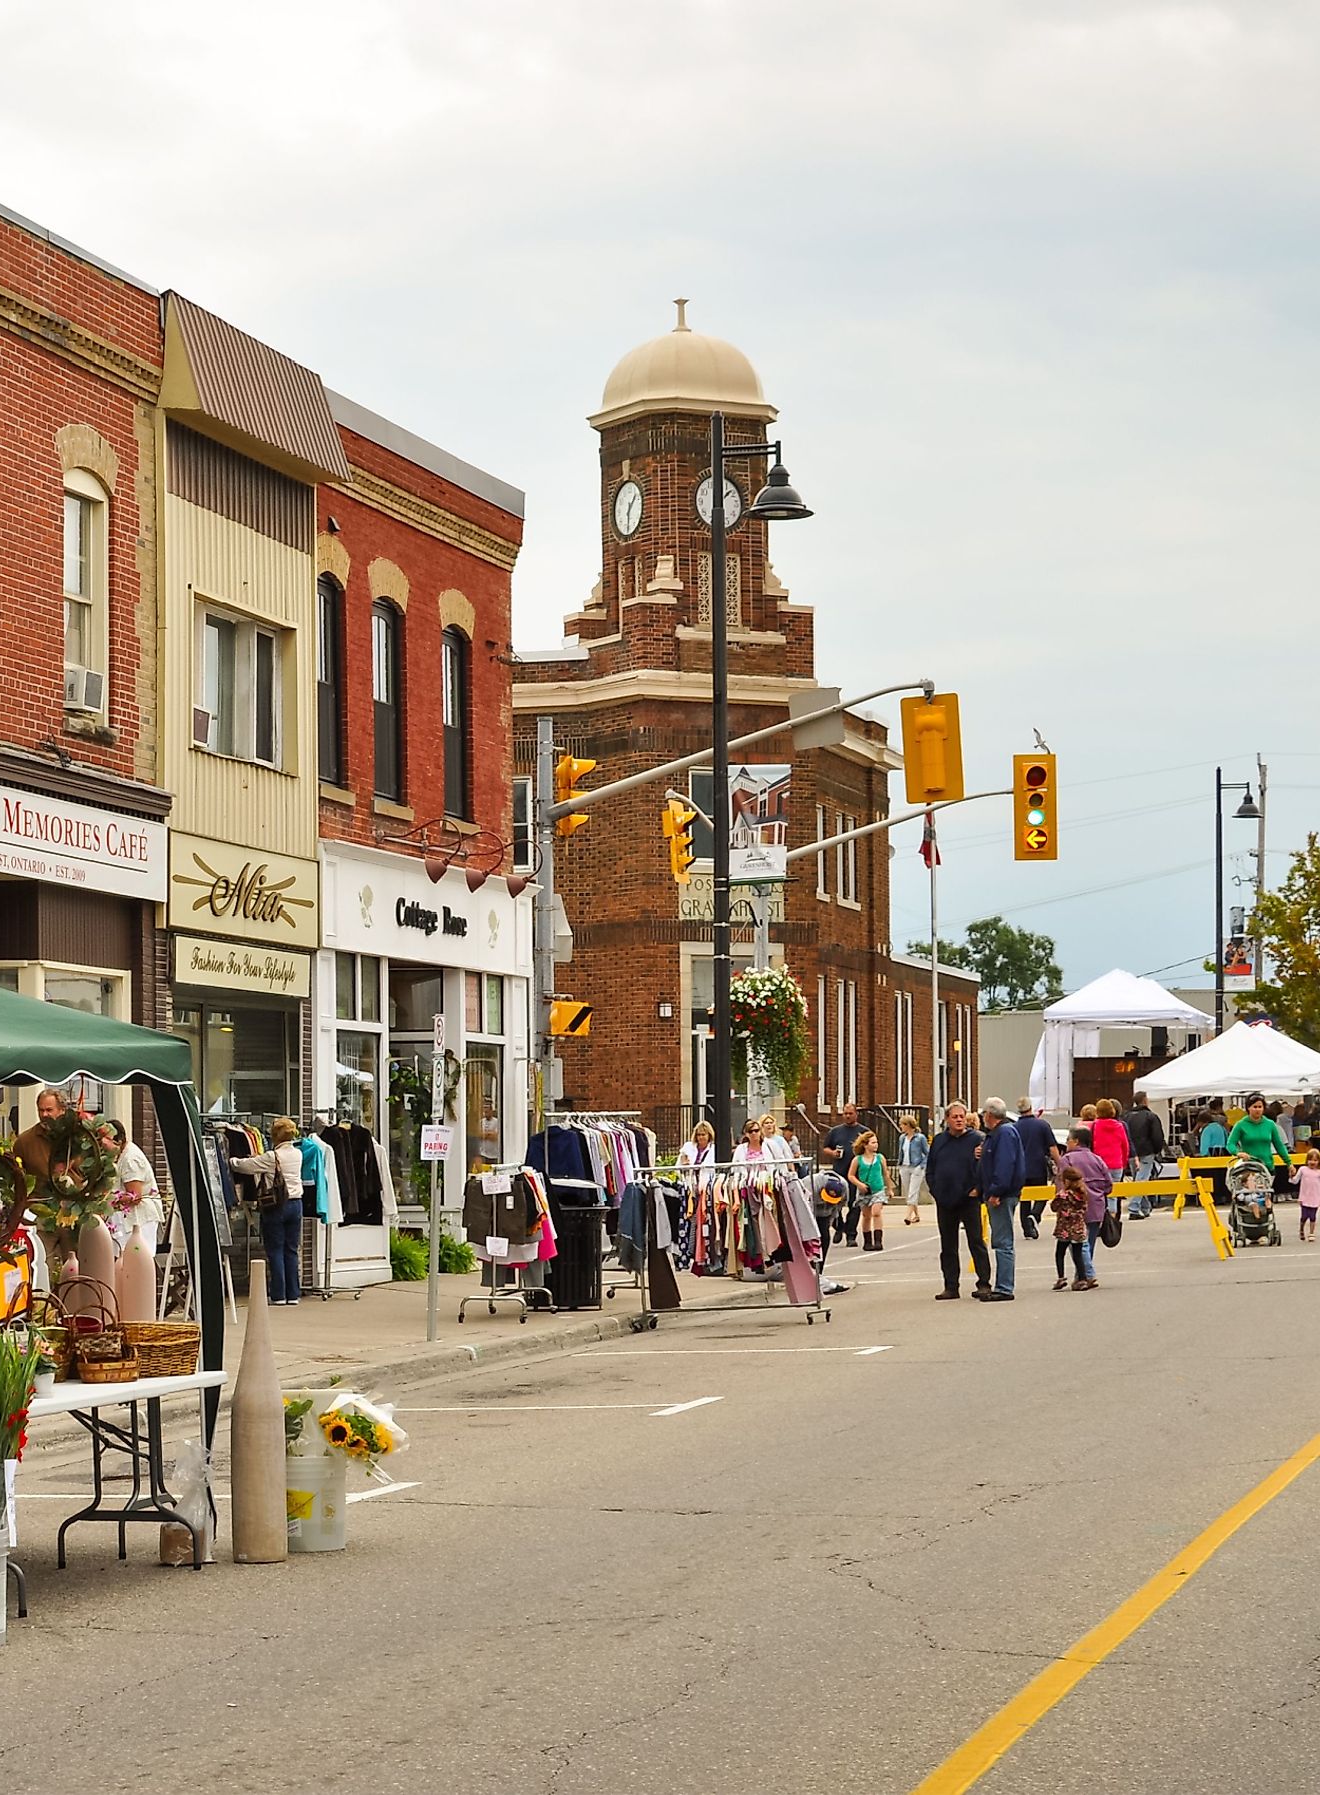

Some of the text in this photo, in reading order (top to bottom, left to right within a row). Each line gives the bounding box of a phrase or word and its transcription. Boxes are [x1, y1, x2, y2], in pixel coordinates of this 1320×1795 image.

[3, 798, 101, 852] MEMORIES
[106, 823, 148, 861] CAFÉ
[11, 856, 46, 874] ONTARIO
[55, 864, 71, 878] EST.
[72, 868, 86, 882] 2009
[210, 862, 284, 923] Mia
[396, 897, 468, 937] Cottage Rose
[190, 946, 296, 991] Fashion For Your Lifestyle
